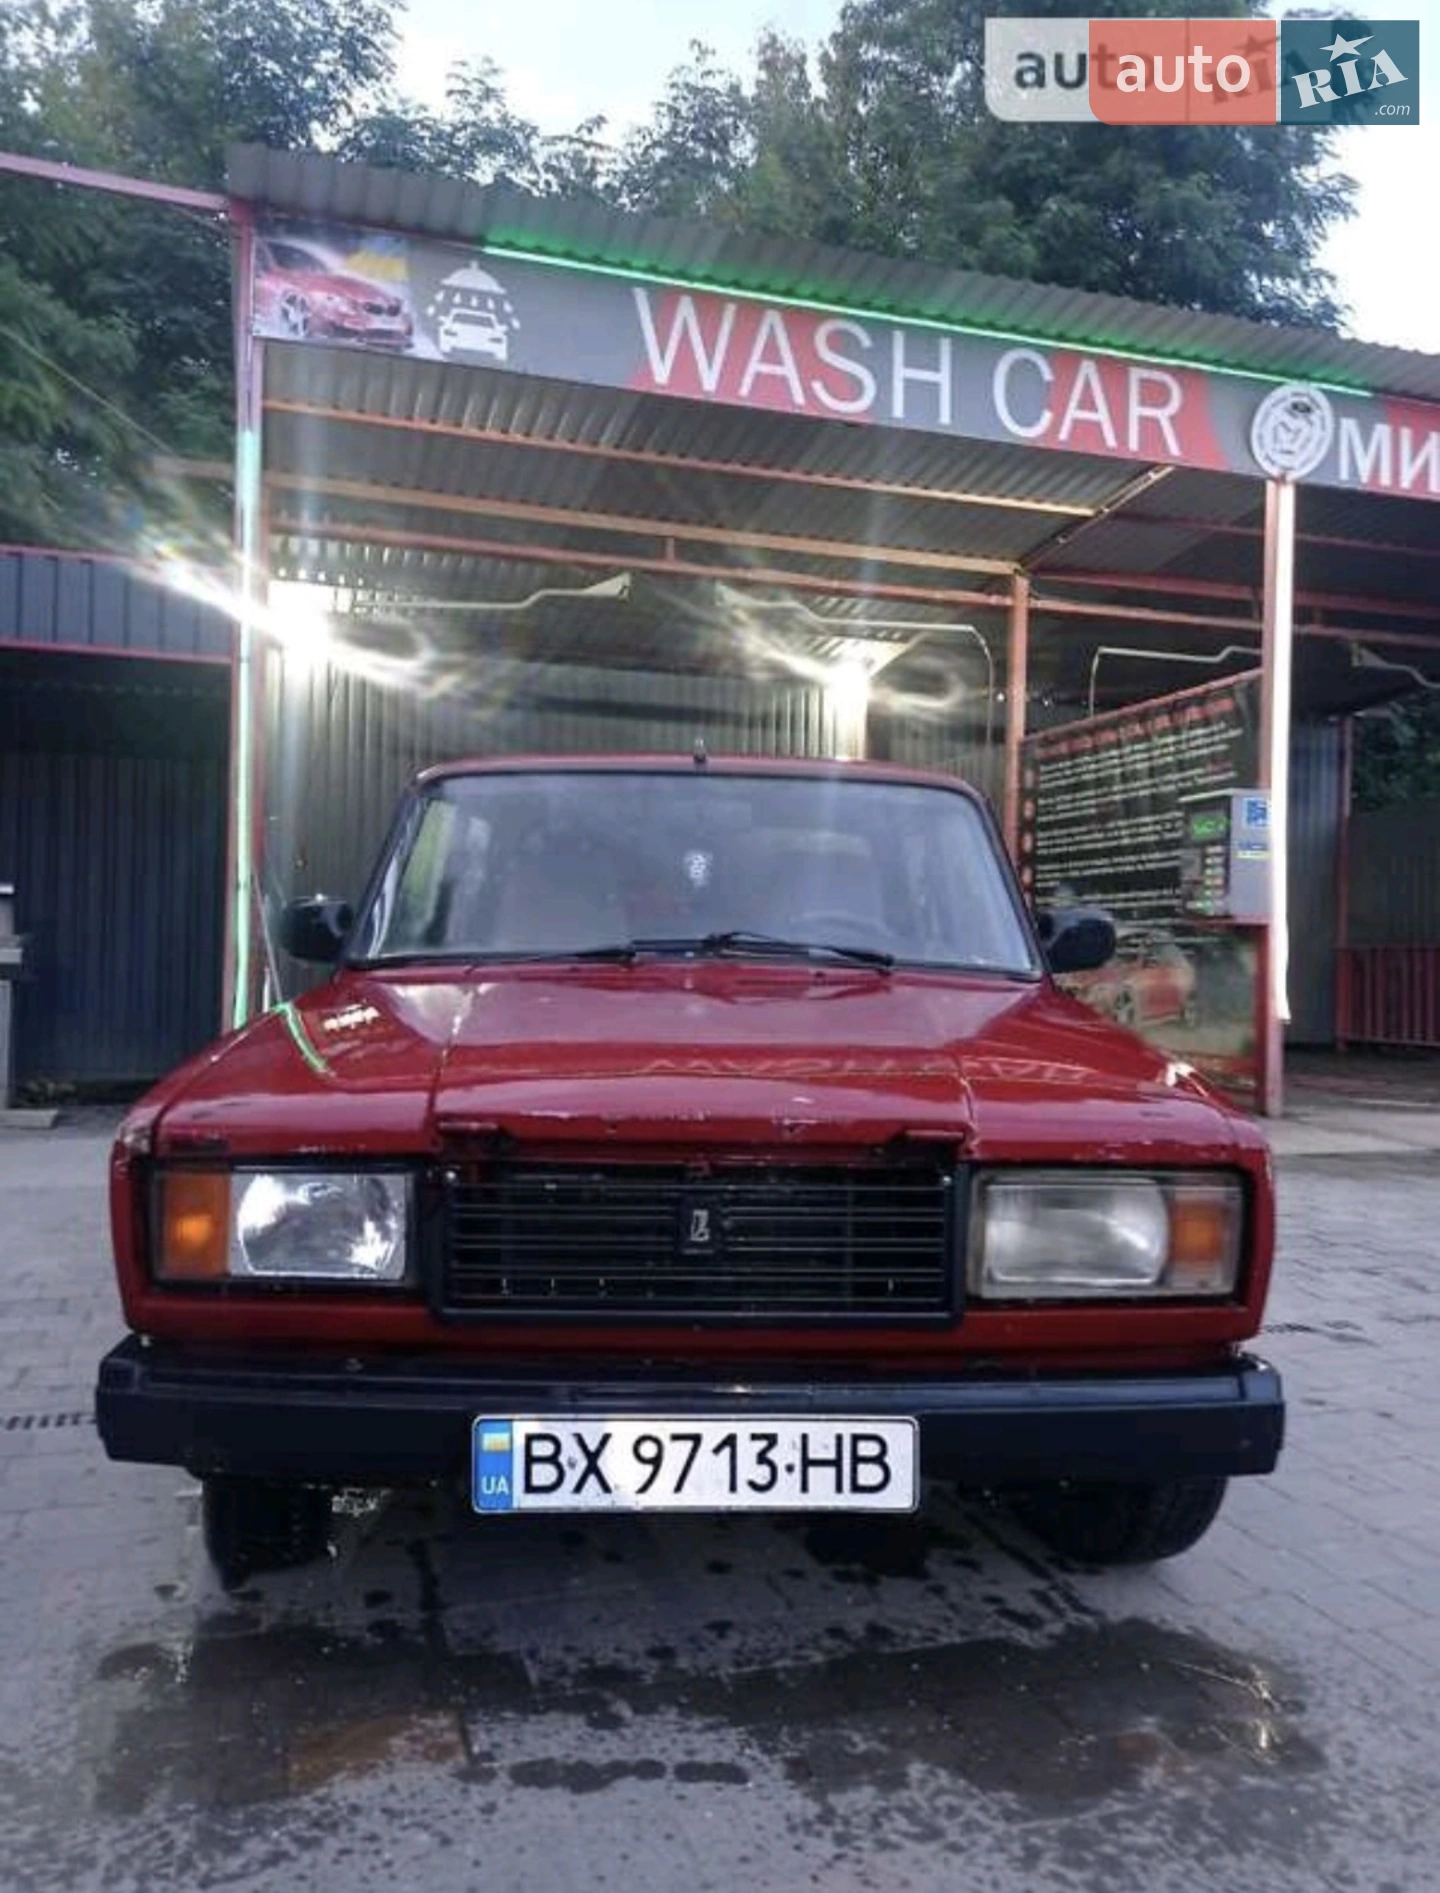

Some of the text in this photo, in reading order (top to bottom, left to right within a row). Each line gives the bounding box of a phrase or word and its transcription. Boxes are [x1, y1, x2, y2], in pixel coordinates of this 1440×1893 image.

[632, 287, 951, 425] WASH
[993, 348, 1182, 456] CAR
[481, 1474, 510, 1496] UA
[524, 1432, 892, 1494] BX 9713 HB
